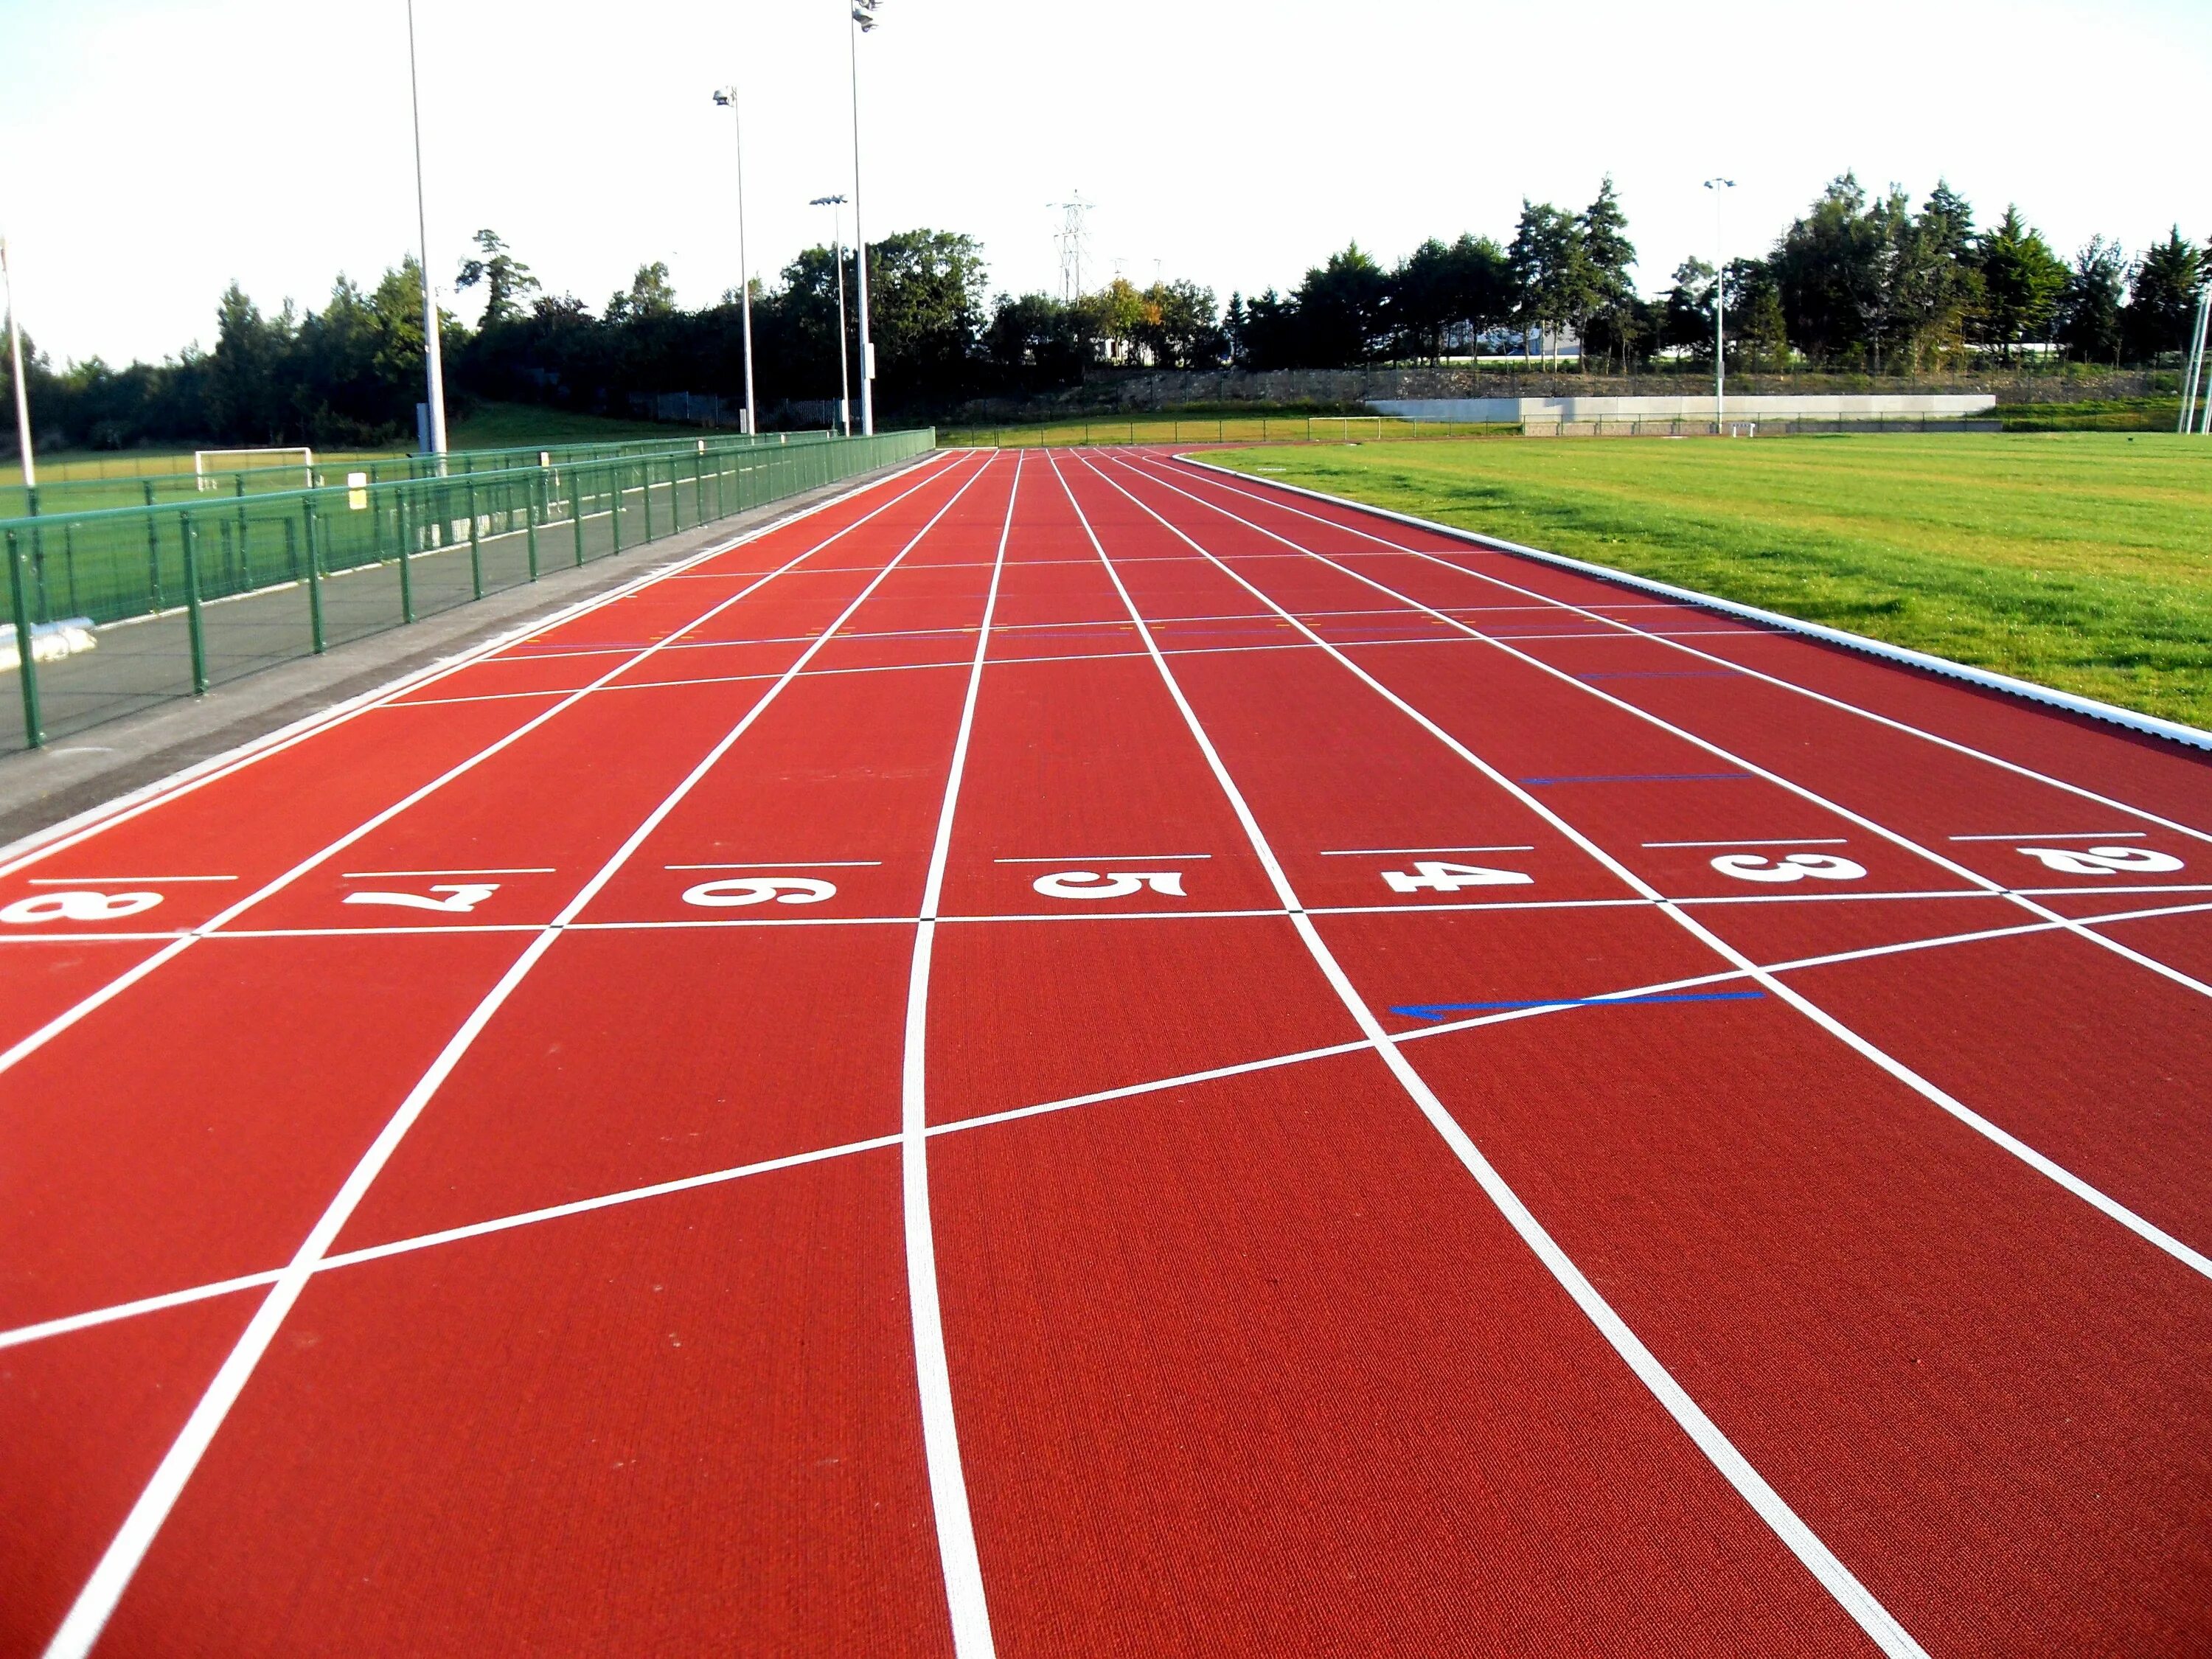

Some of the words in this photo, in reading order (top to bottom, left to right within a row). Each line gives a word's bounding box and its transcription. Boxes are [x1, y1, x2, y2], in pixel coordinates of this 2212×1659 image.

[1710, 853, 1868, 883] 3
[2015, 846, 2185, 874] 2
[681, 877, 838, 907] 6
[1032, 871, 1188, 900] 5
[1380, 861, 1535, 893] 4
[0, 890, 165, 925] 8
[341, 883, 502, 913] 7
